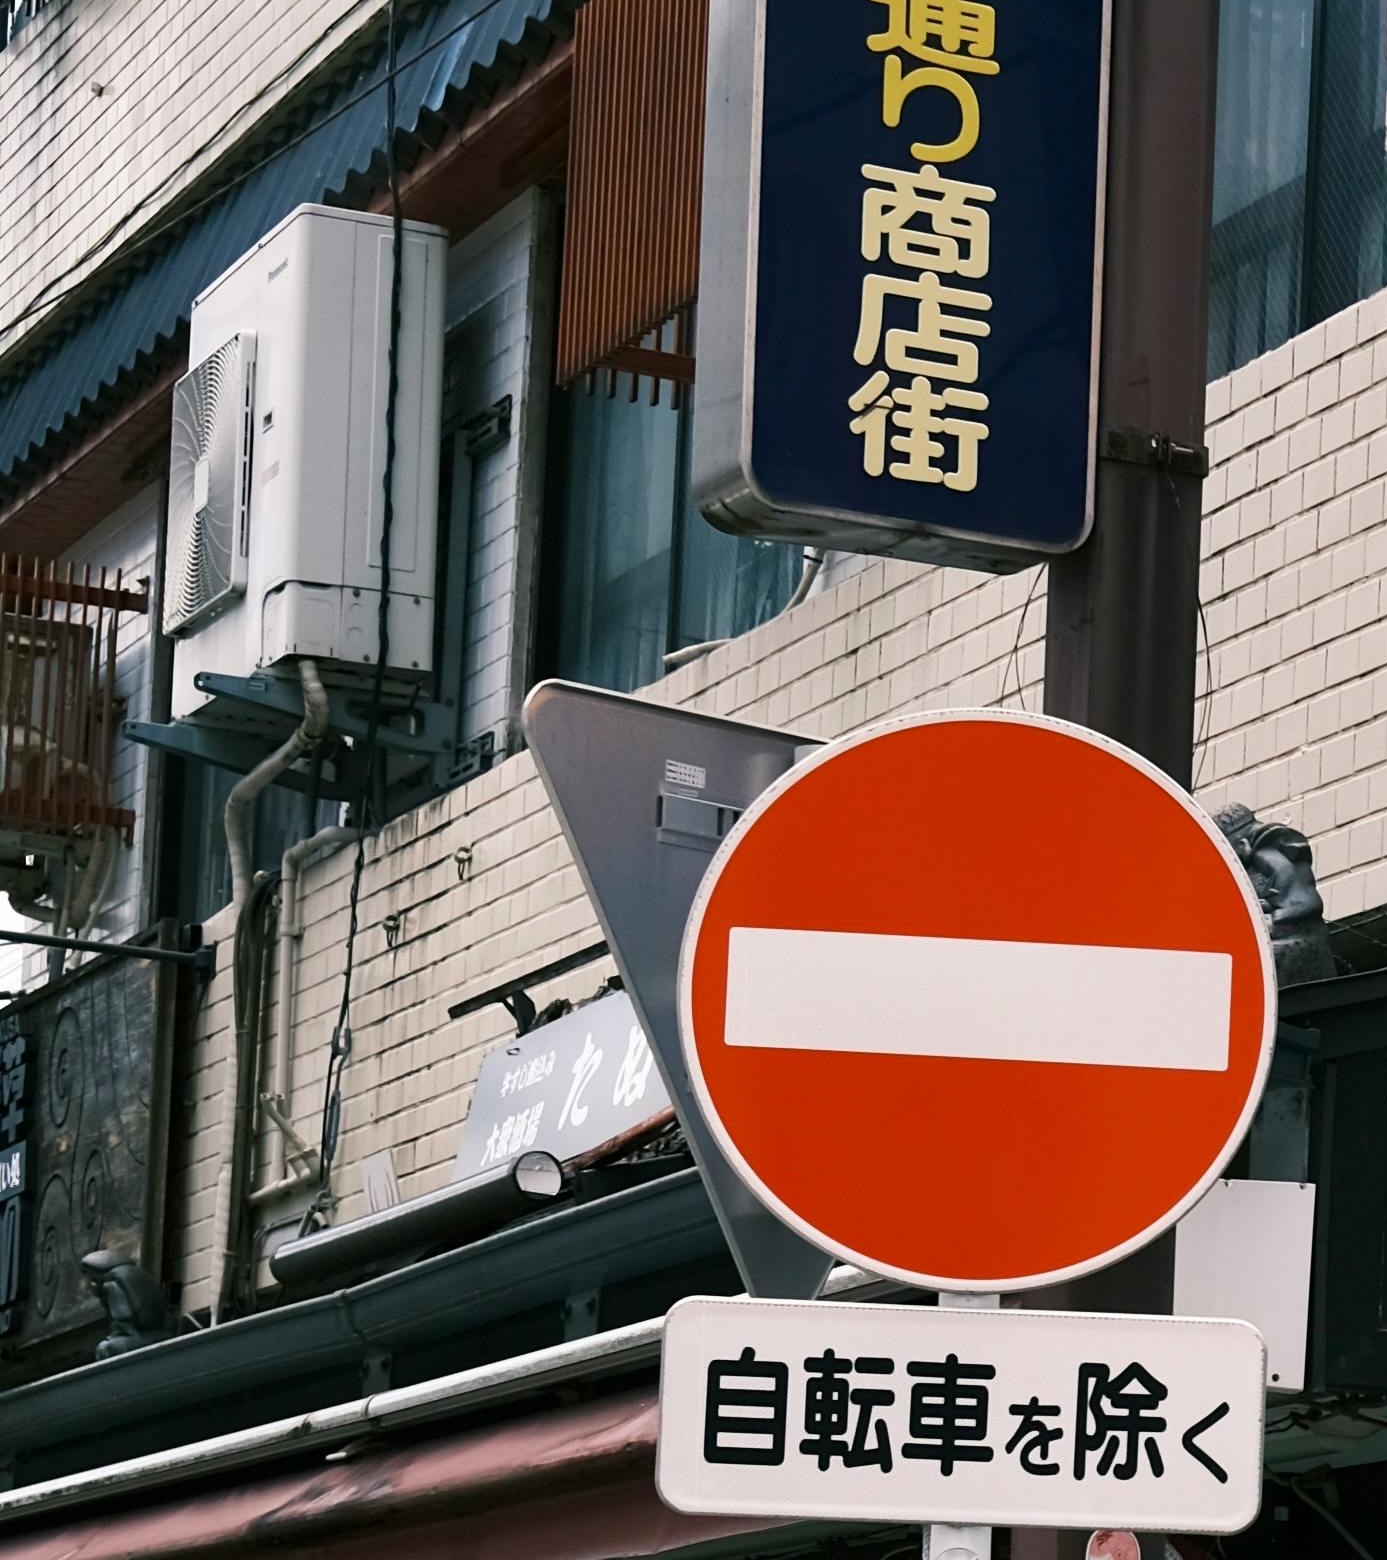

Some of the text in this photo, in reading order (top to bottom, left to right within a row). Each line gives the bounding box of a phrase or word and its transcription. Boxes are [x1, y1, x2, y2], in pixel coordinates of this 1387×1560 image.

[702, 1345, 1232, 1485] 自転車を除く
